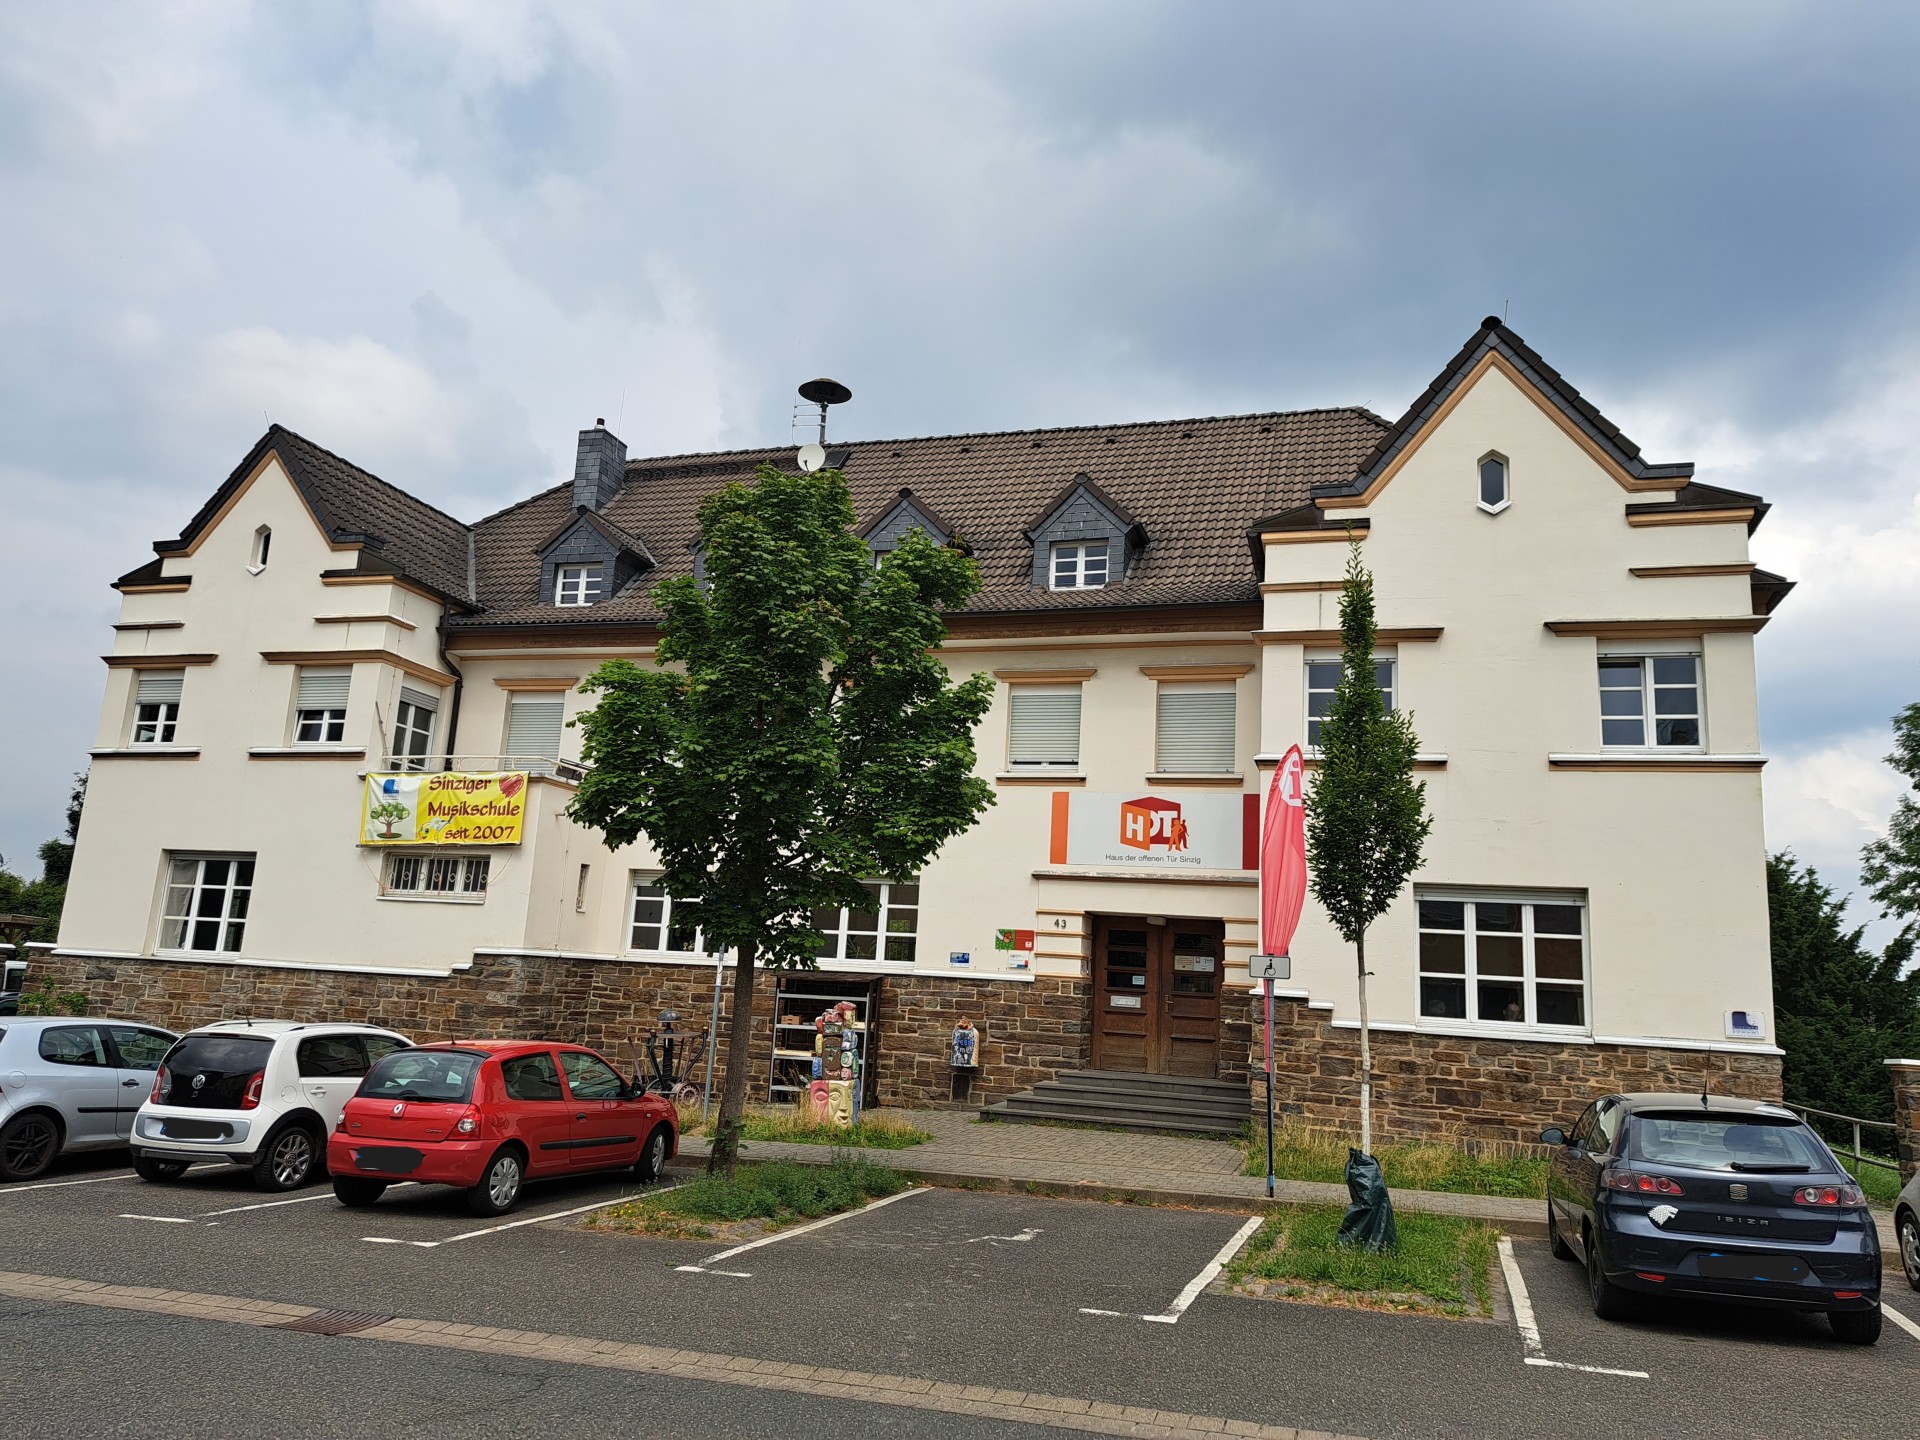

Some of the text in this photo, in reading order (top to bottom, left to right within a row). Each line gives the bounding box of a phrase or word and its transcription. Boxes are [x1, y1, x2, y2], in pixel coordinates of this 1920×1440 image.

[428, 775, 492, 795] Sinziger
[427, 800, 521, 817] Musikschule
[444, 825, 516, 840] seit 2007
[1105, 853, 1202, 865] Haus der offenen Tür Sinzig
[1053, 918, 1067, 930] 43
[1717, 1215, 1769, 1226] IBIZA
